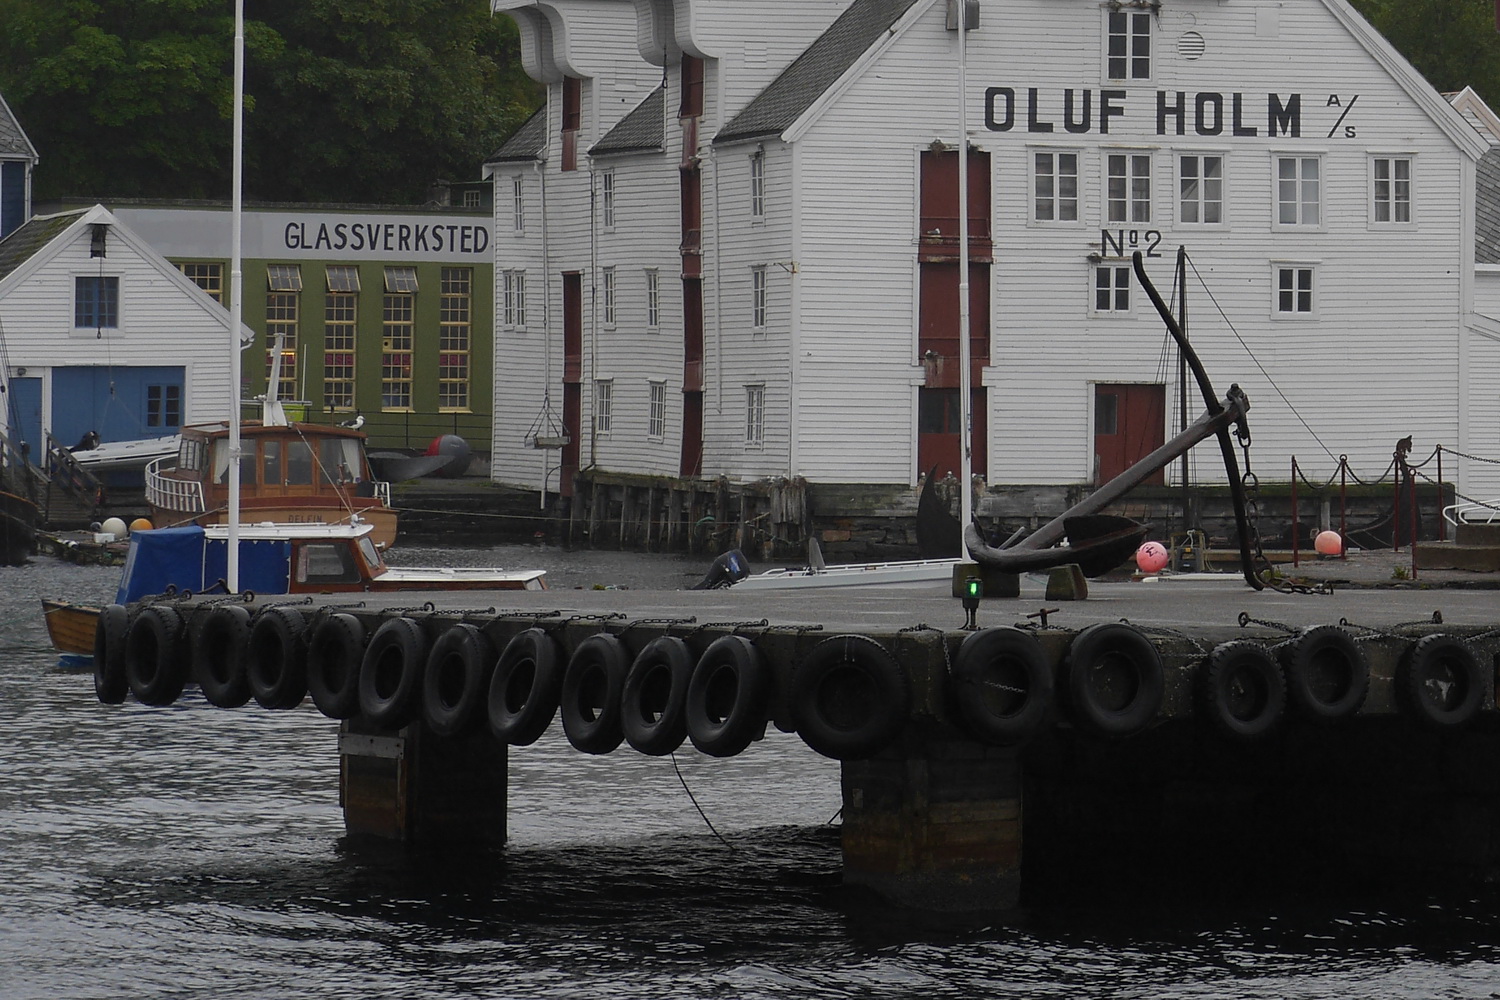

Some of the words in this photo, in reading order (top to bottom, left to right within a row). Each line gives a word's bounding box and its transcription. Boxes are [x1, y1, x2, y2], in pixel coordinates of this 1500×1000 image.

[984, 86, 1127, 134] OLUF
[1156, 90, 1301, 138] HOLM
[1326, 94, 1360, 139] A/S
[284, 221, 489, 254] GLASSVERKSTED
[288, 514, 322, 523] DELFIN
